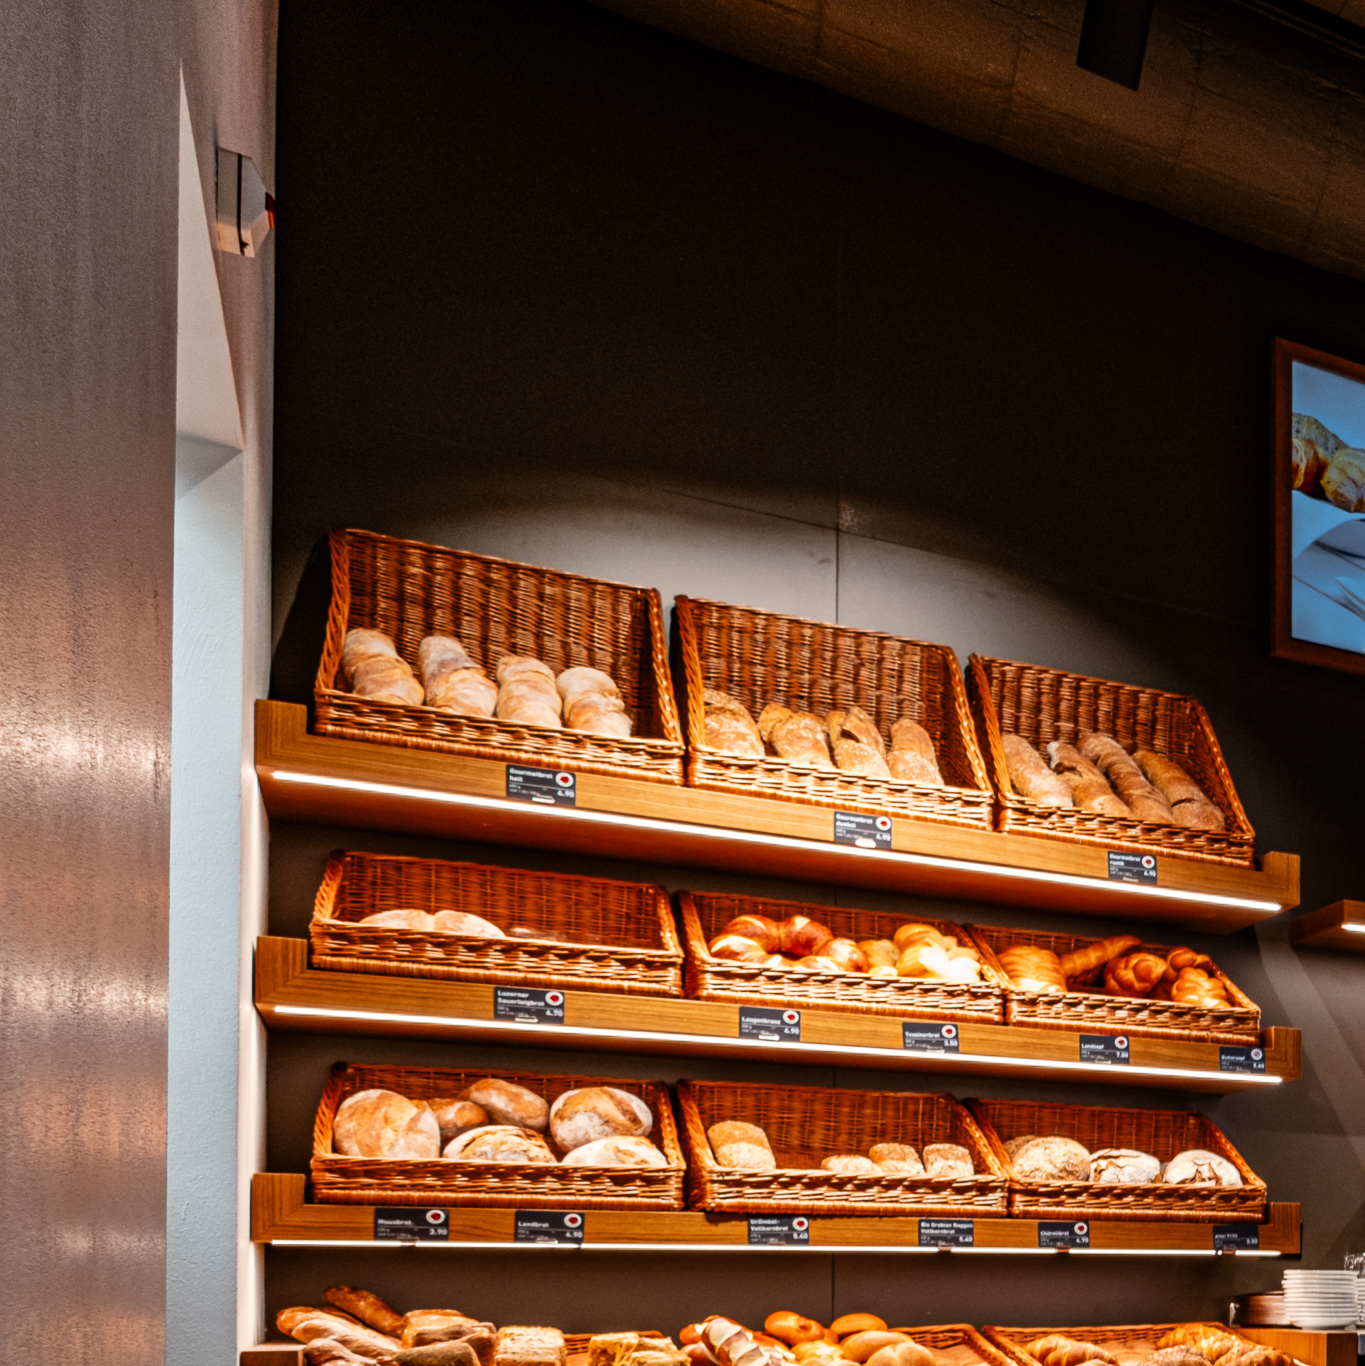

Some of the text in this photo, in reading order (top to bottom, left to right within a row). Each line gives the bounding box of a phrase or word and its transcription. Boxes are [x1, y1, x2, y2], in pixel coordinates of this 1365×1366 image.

[509, 767, 553, 781] Gourmetbrot
[557, 789, 575, 798] 4.90
[1143, 869, 1156, 877] 4.90
[545, 1009, 564, 1017] 4.70
[783, 1027, 800, 1035] 4.90
[429, 1228, 448, 1236] 3.90
